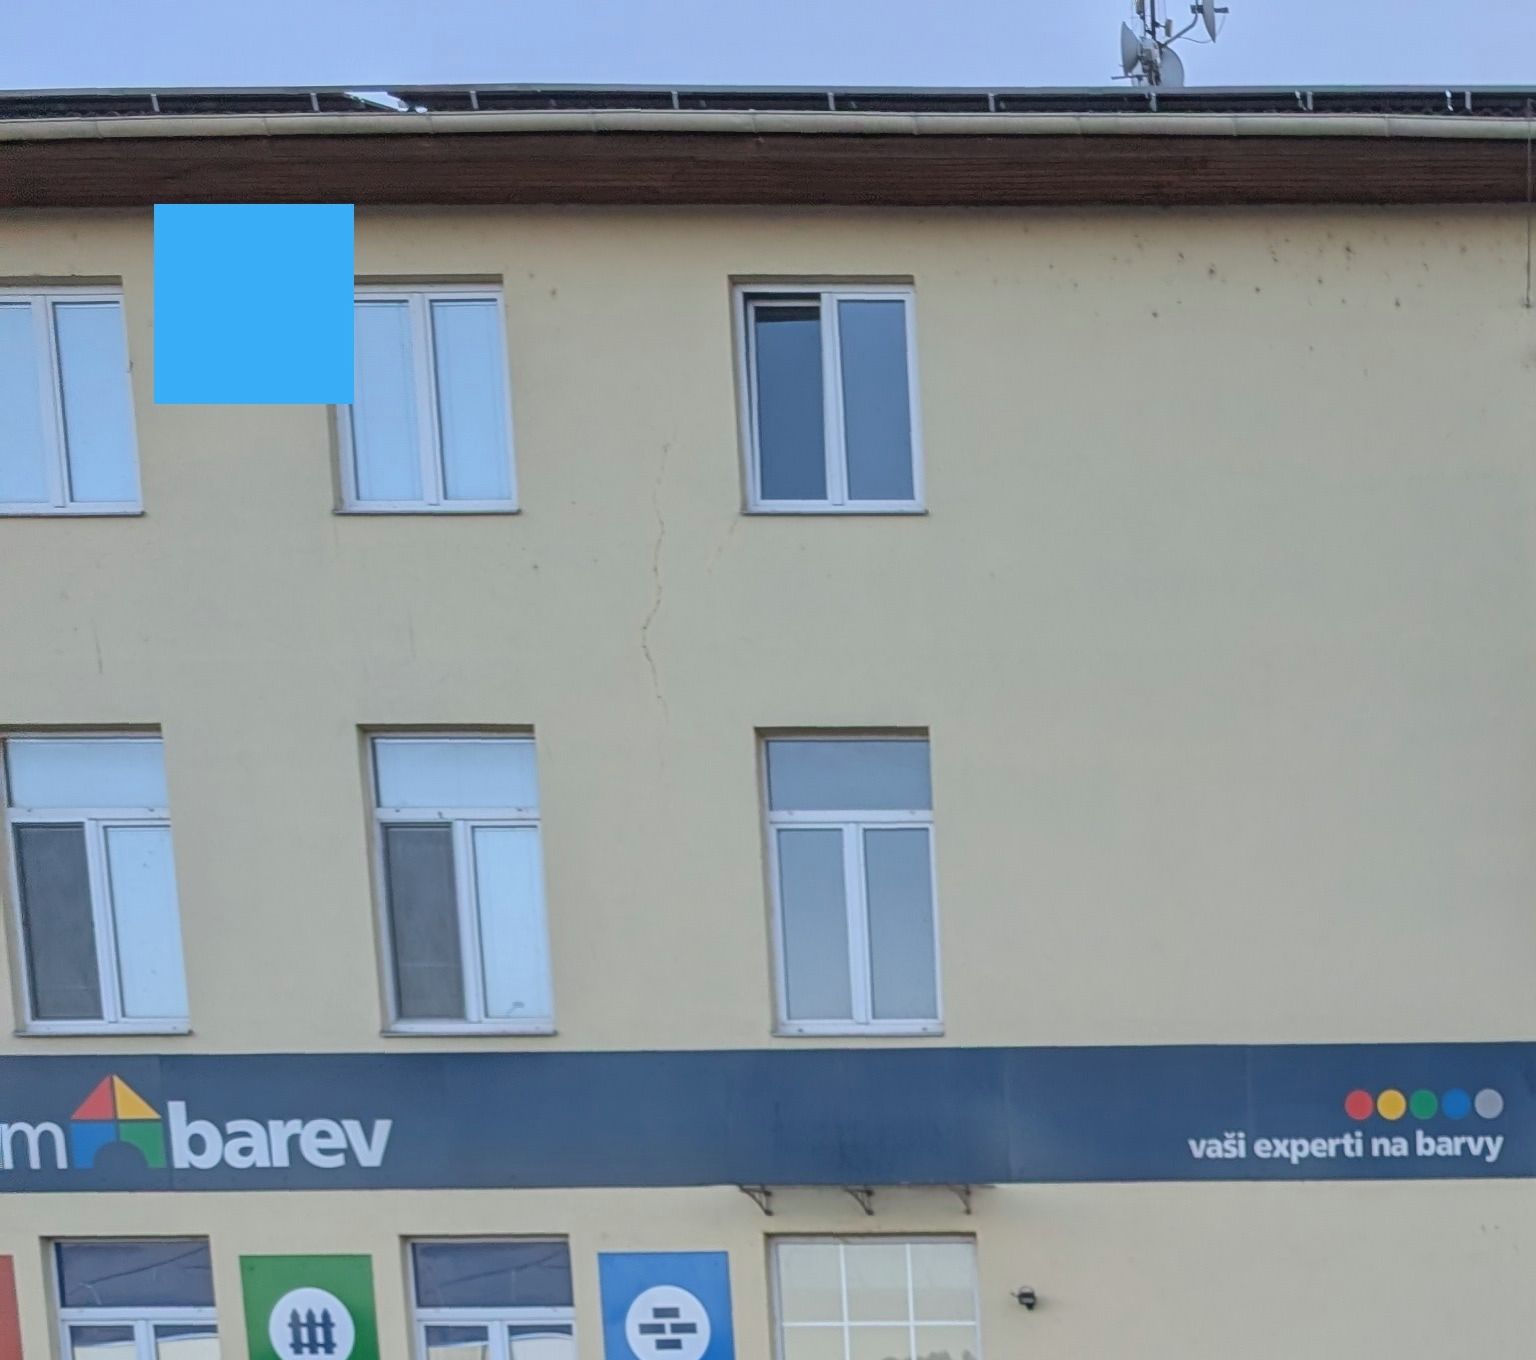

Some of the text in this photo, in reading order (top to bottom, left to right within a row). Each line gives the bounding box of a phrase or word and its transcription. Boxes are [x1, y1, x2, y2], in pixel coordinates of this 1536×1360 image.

[167, 1100, 393, 1169] barev
[1188, 1129, 1504, 1165] vaši experti na barvy
